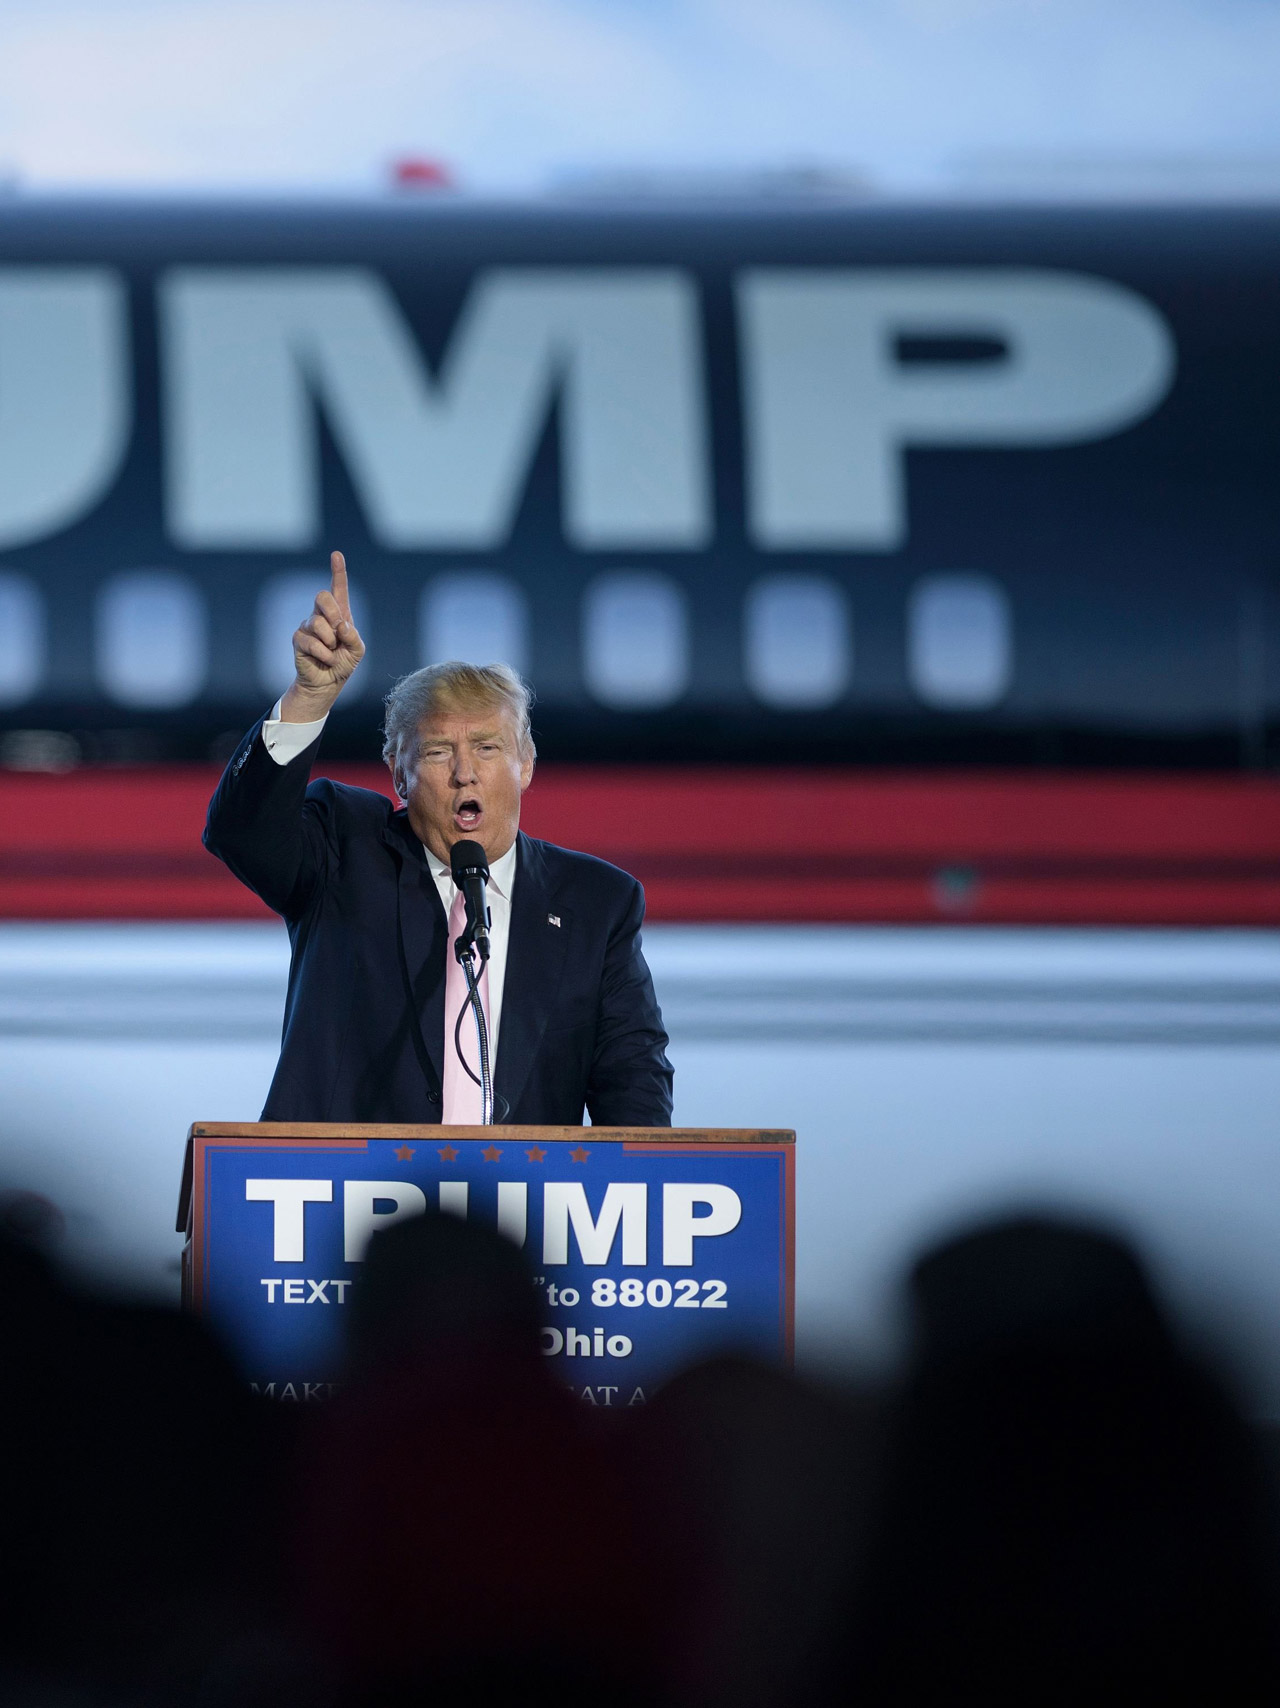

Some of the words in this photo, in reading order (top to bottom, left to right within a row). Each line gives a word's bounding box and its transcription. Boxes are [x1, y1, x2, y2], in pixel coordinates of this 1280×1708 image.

[260, 1279, 353, 1304] TEXT
[590, 1278, 729, 1308] 88022
[540, 1326, 633, 1357] Ohio
